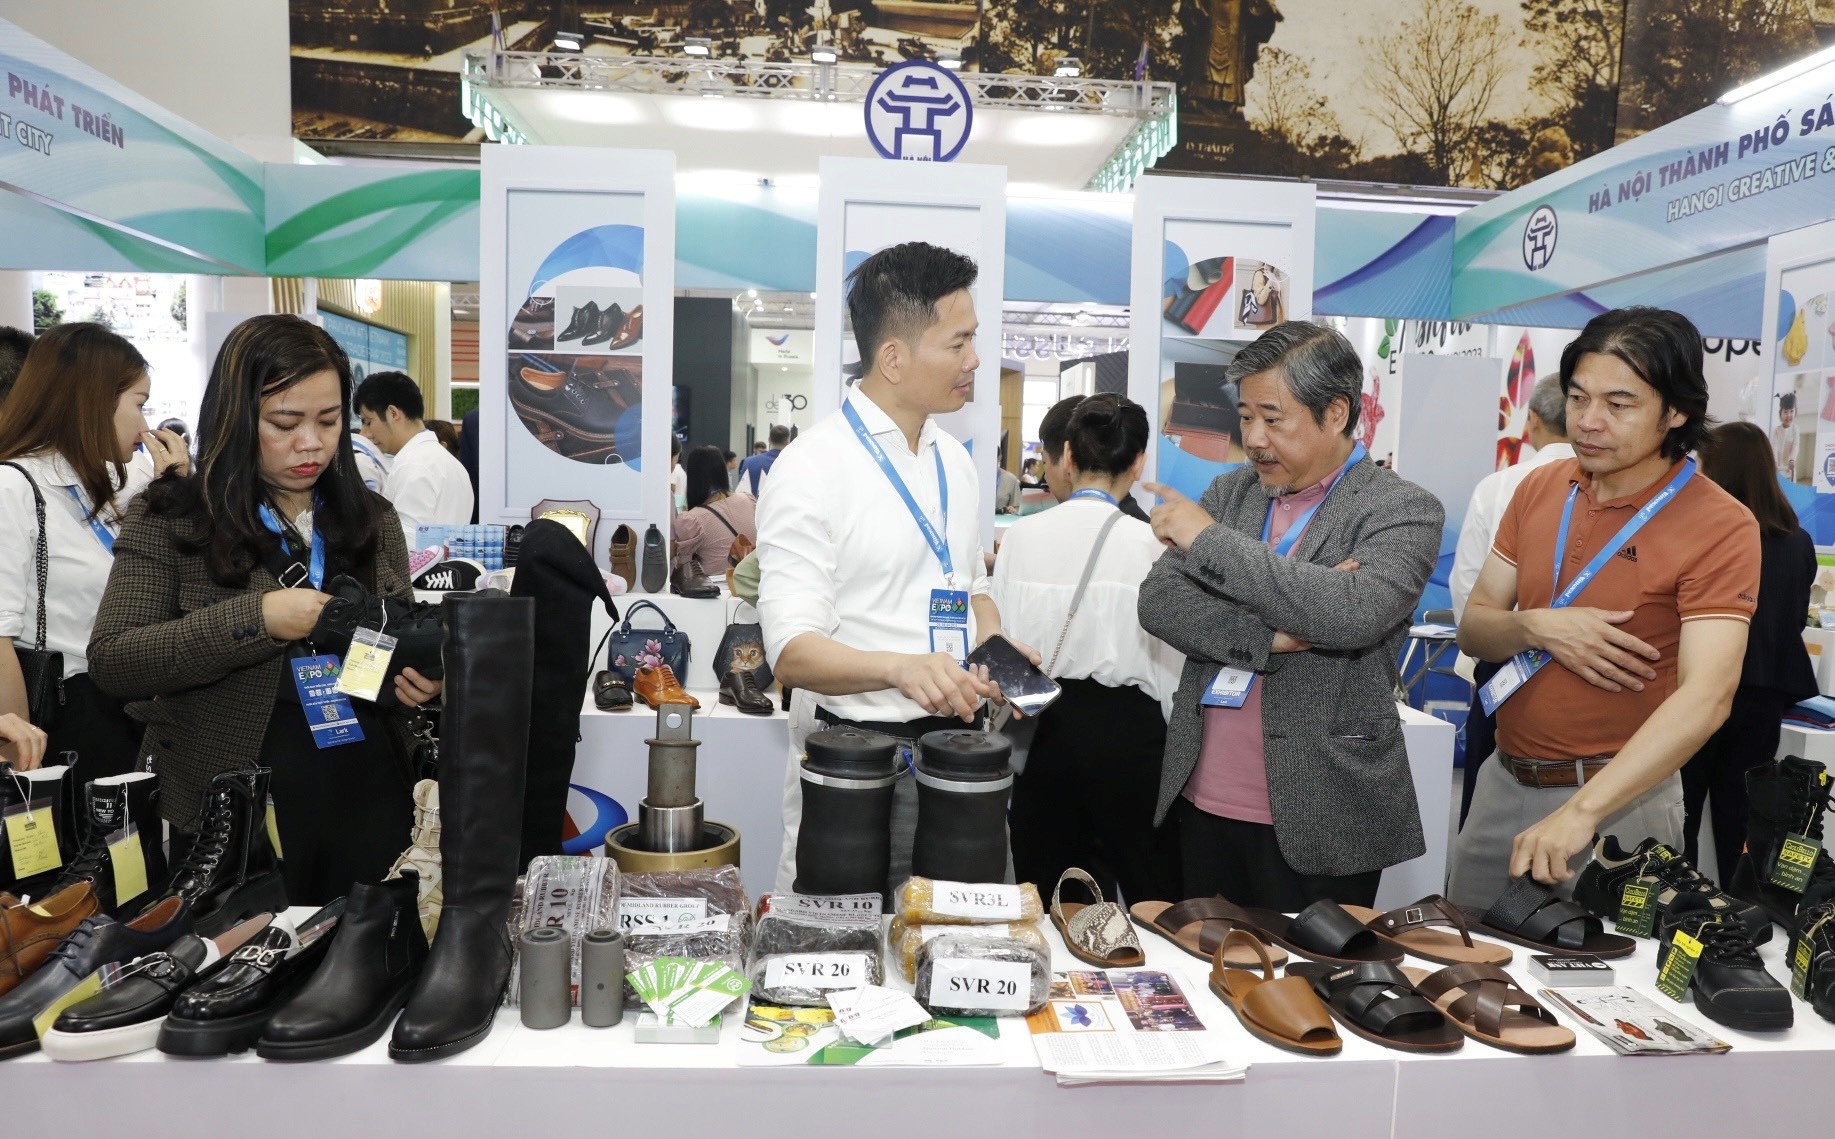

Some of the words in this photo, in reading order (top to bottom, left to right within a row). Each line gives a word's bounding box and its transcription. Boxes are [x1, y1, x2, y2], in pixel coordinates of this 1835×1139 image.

[8, 72, 64, 120] PHÁT
[72, 104, 124, 149] TRIỂN
[0, 111, 12, 139] T
[15, 120, 54, 156] CITY
[1588, 183, 1611, 214] HÀ
[1617, 170, 1652, 203] NỘI
[1659, 141, 1730, 188] THÀNH
[1738, 109, 1792, 159] PHỐ
[1799, 94, 1835, 136] SÁ
[1667, 184, 1725, 222] HANOI
[1727, 151, 1818, 202] CREATIVE
[1617, 551, 1638, 562] adidas
[931, 604, 951, 614] EXPO
[297, 664, 321, 672] VIETNAM
[298, 670, 322, 683] EXPO
[1783, 850, 1811, 861] SAFETY
[549, 888, 569, 908] 10
[798, 899, 843, 909] SVR
[853, 901, 873, 909] 10
[949, 890, 1009, 907] SVR3L
[534, 901, 544, 928] IDLAND
[620, 914, 655, 929] RSS
[785, 962, 824, 977] SVR
[831, 963, 850, 977] 20
[949, 976, 991, 994] SVR
[996, 979, 1017, 996] 20
